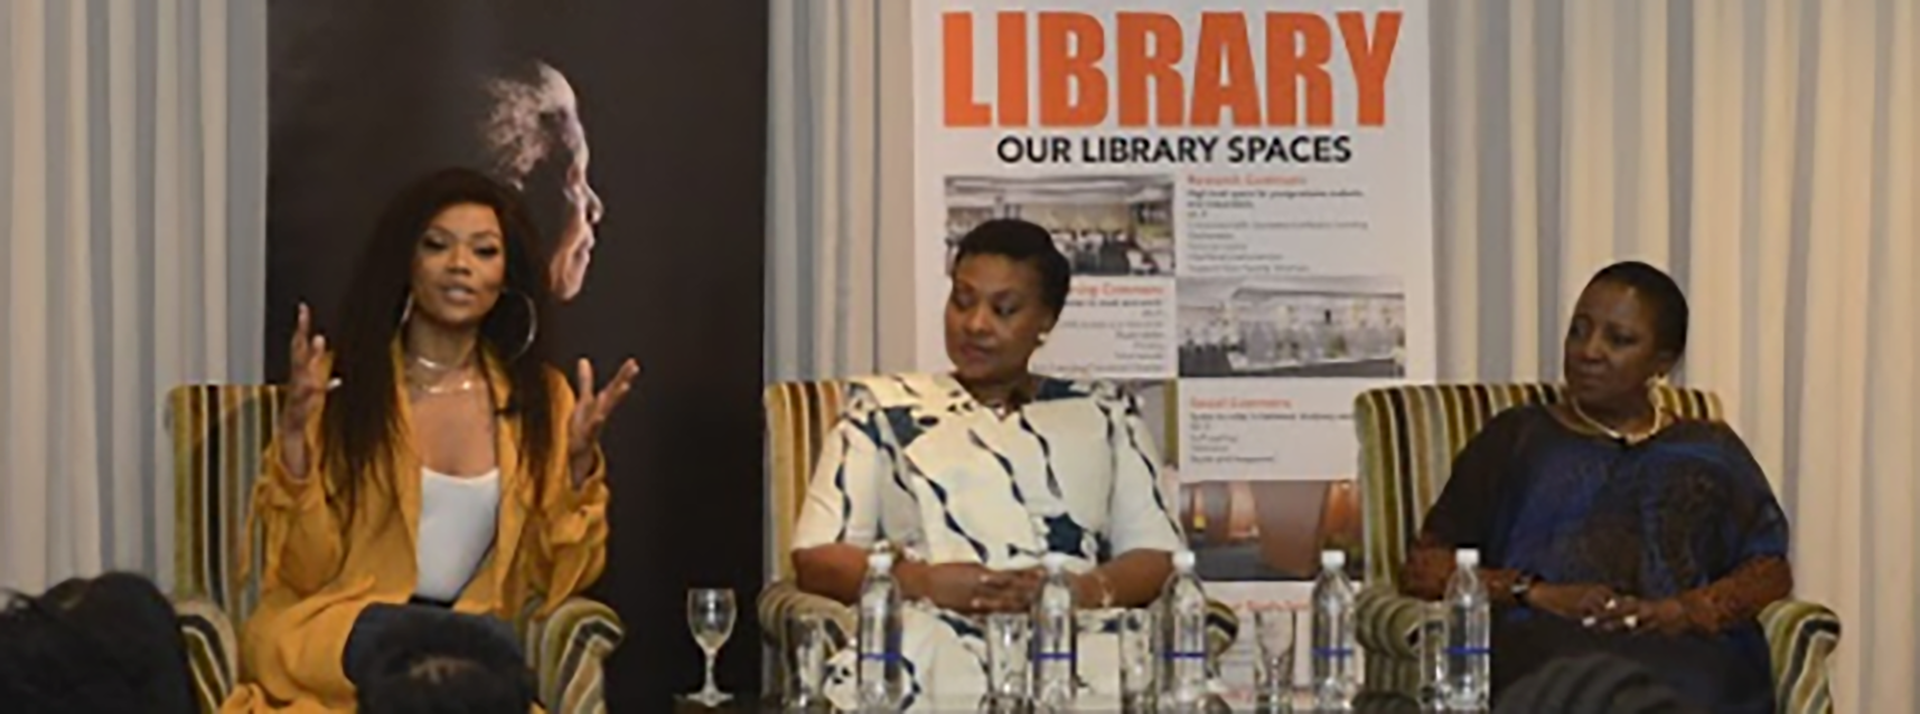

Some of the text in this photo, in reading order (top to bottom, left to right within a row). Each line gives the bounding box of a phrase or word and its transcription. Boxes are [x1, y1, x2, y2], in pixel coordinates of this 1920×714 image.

[942, 11, 1404, 128] LIBRARY
[996, 135, 1352, 163] OUR LIBRARY SPACES
